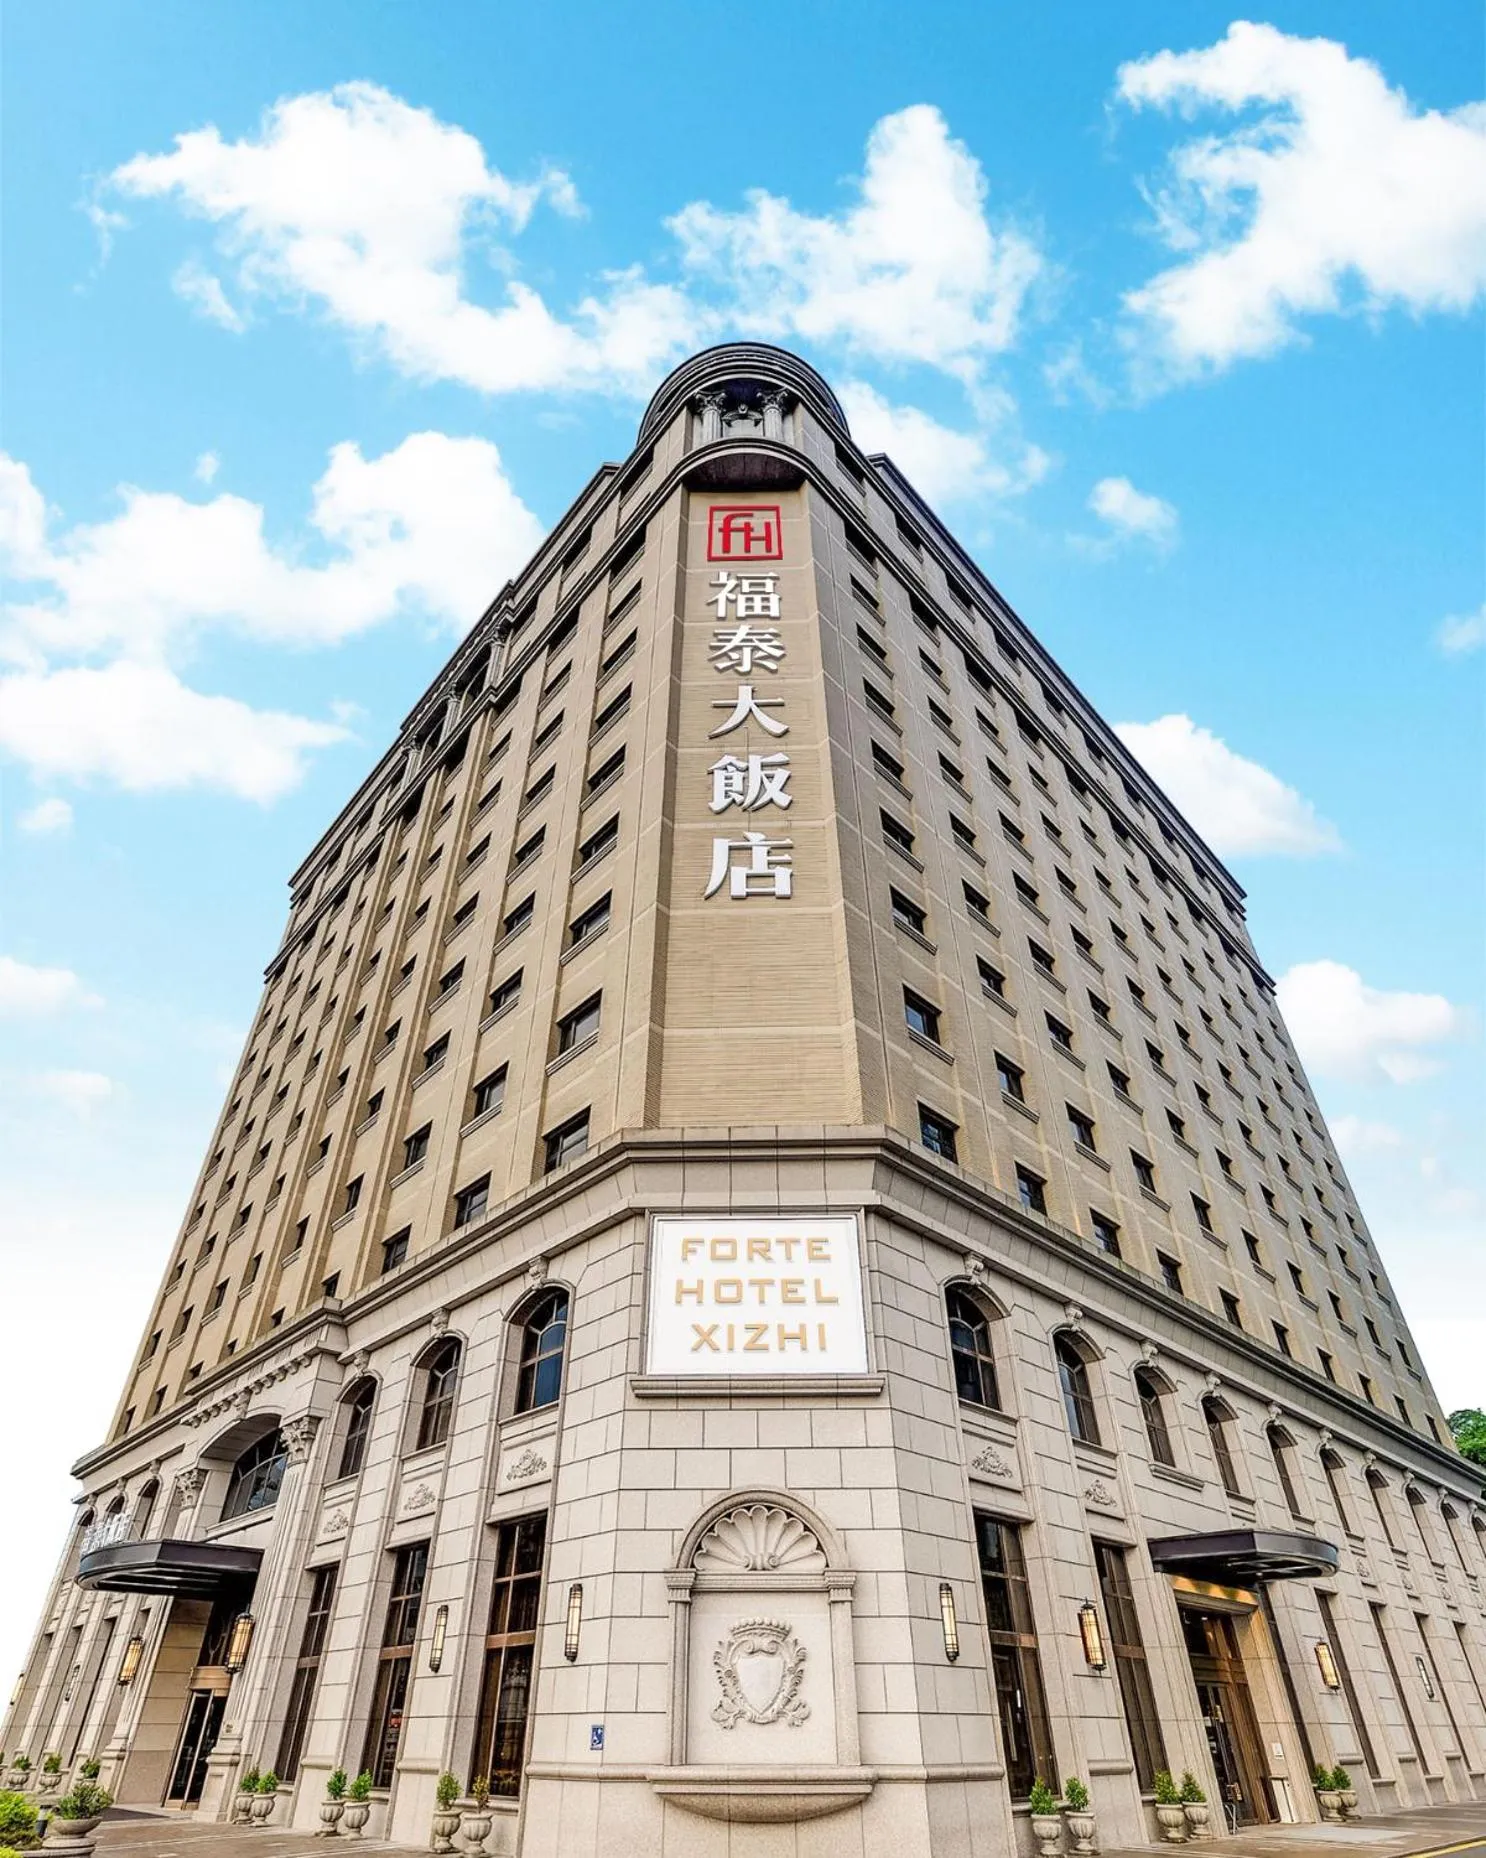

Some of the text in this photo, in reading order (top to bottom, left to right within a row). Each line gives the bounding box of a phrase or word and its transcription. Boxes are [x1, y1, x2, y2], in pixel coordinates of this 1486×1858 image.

[703, 571, 793, 900] 福泰大飯店
[681, 1237, 832, 1261] FORTE
[675, 1277, 839, 1304] HOTEL
[690, 1322, 827, 1351] XIZHI
